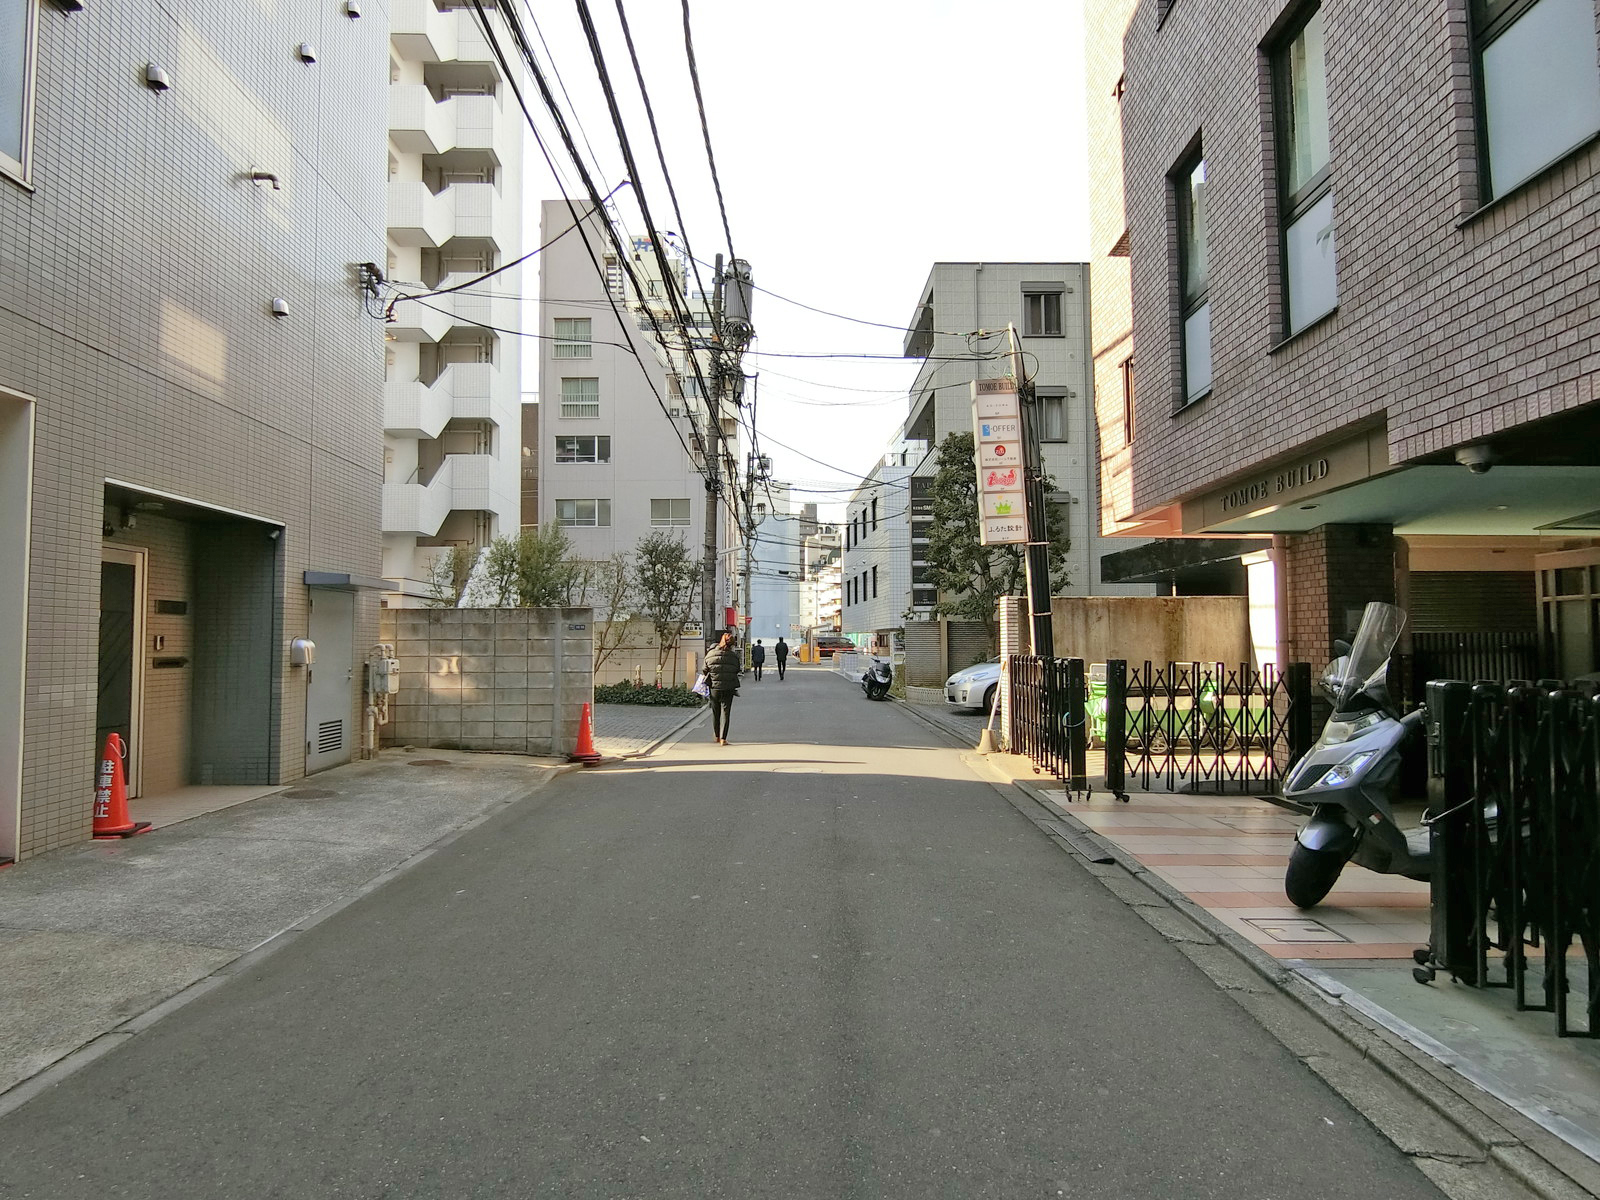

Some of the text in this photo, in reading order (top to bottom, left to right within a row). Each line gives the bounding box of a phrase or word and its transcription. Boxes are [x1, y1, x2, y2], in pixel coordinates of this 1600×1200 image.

[978, 382, 997, 392] TOMOE
[1220, 458, 1329, 512] TOMOE BUILD
[94, 759, 115, 818] 駐車禁止
